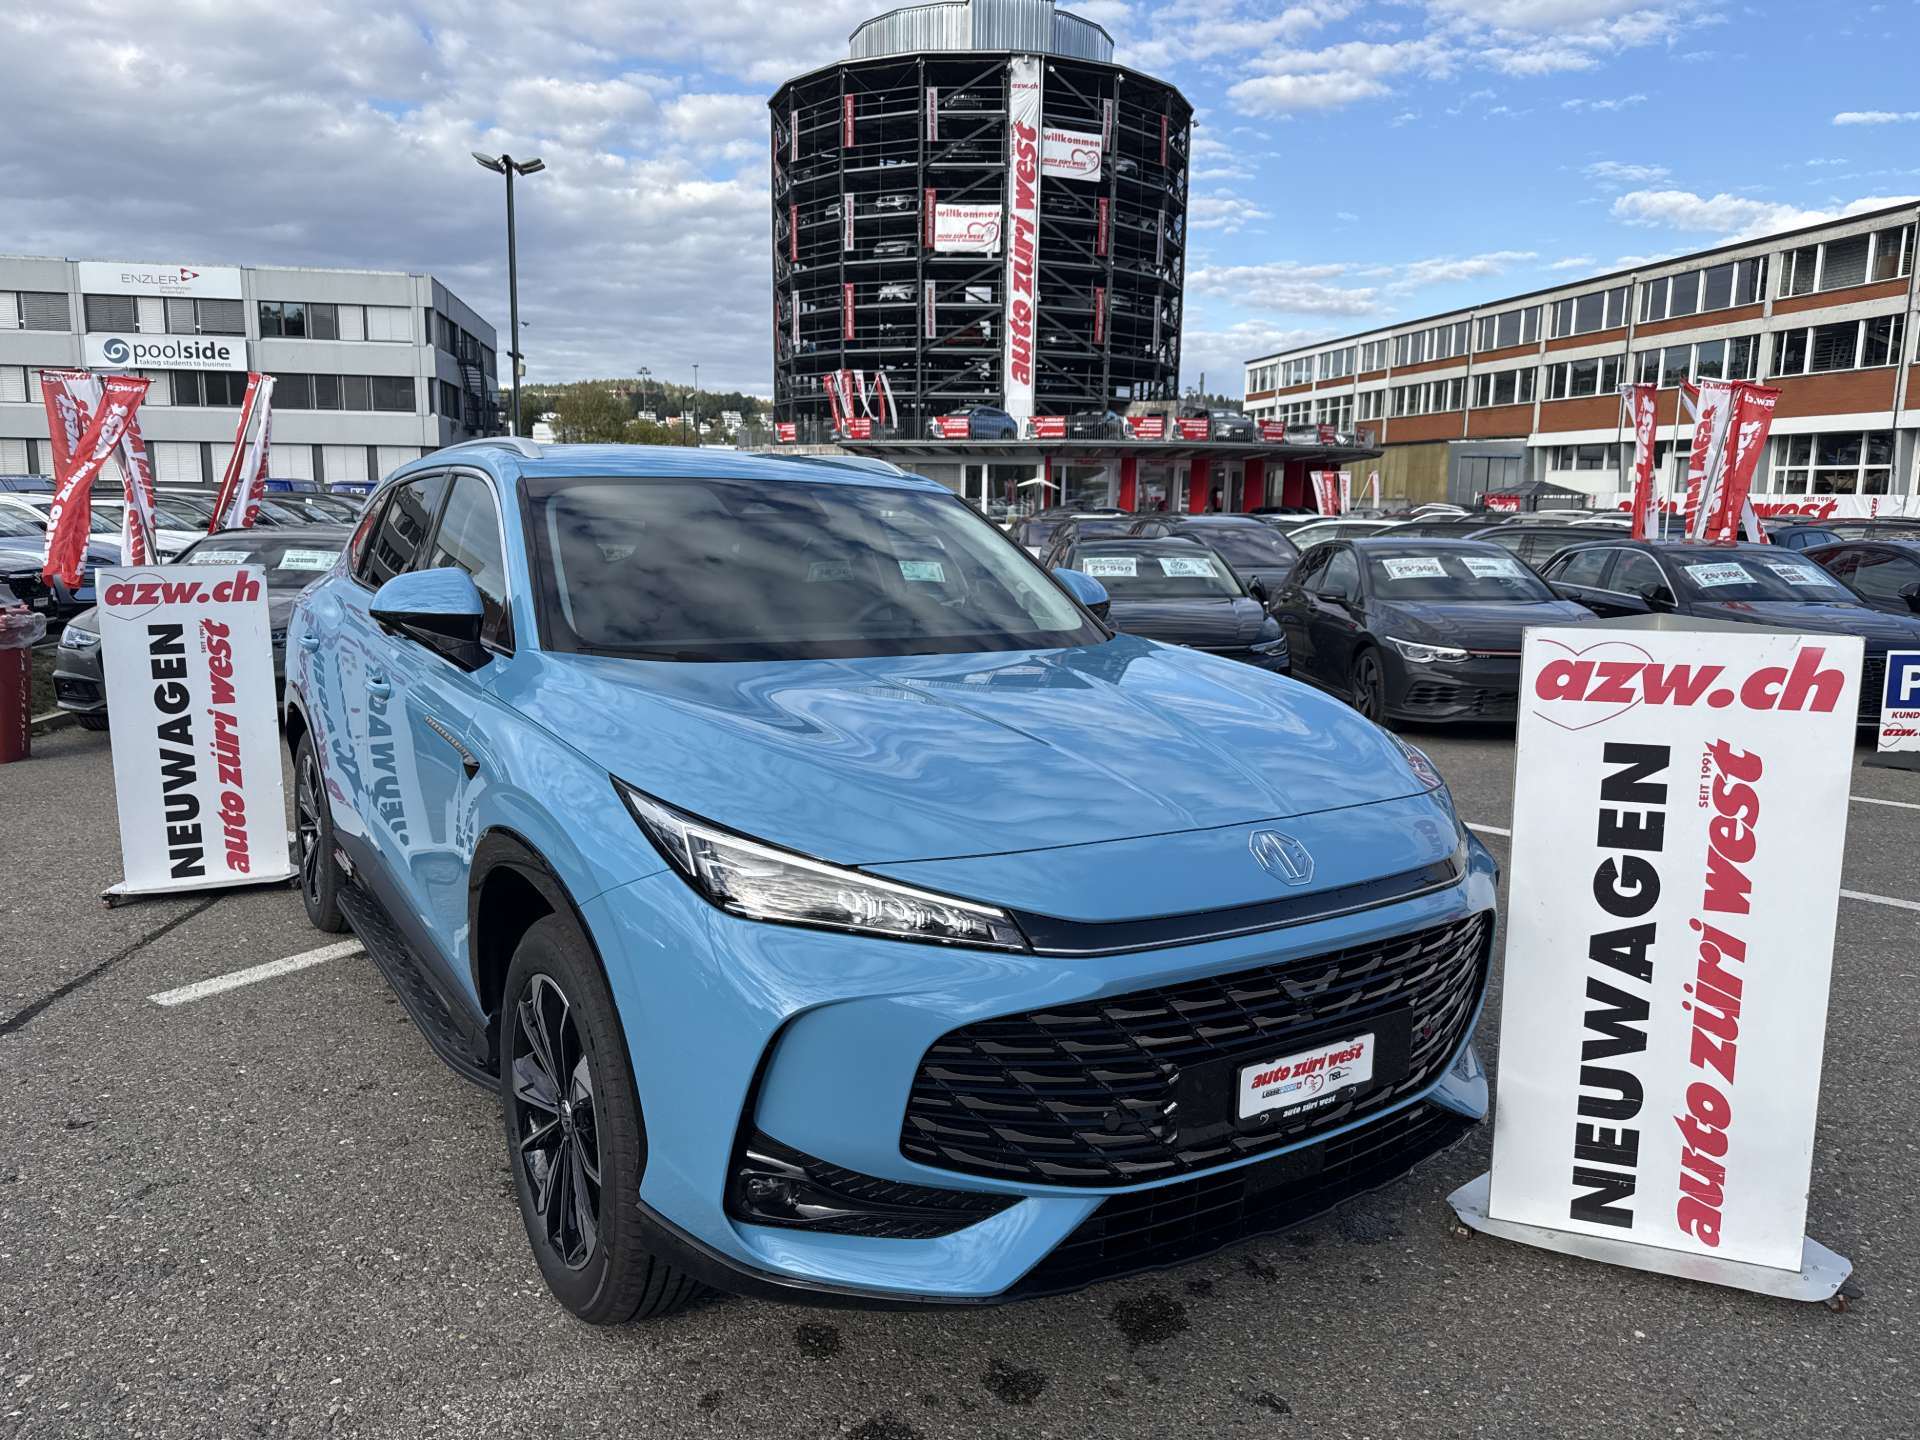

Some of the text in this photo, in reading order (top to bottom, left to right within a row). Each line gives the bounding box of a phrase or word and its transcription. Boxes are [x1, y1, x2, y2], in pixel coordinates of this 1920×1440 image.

[1043, 133, 1100, 147] willkommen
[937, 209, 999, 218] willkommen
[1009, 120, 1037, 385] auto züri west
[121, 273, 178, 285] ENZLER
[133, 340, 231, 364] poolside
[140, 359, 161, 367] taking
[91, 403, 128, 460] west
[104, 570, 260, 606] azw.ch
[1535, 646, 1846, 713] azw.ch
[1900, 664, 1920, 700] P
[147, 623, 206, 879] NEUWAGEN
[200, 617, 250, 874] auto züri west
[1882, 728, 1920, 736] azw.
[1698, 751, 1713, 808] SEIT 1991
[1569, 741, 1671, 1229] NEUWAGEN
[1673, 737, 1763, 1248] auto züri west
[1251, 1044, 1364, 1089] auto züri west
[1282, 1095, 1337, 1118] auto züri west
